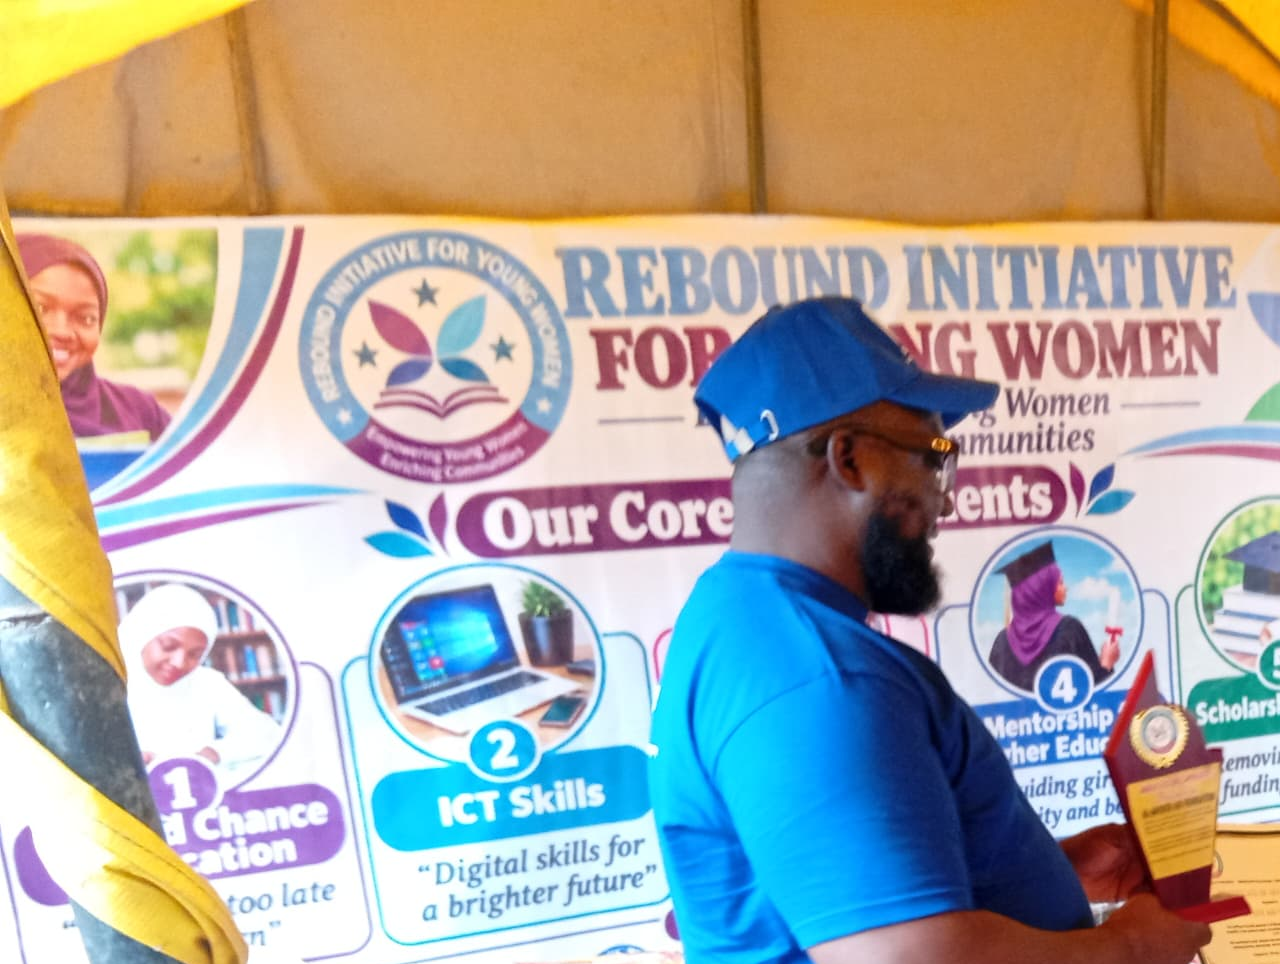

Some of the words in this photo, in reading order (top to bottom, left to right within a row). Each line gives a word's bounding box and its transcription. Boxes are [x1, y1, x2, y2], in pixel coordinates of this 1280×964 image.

[324, 238, 423, 308] INITIATIVE
[427, 236, 470, 265] FOR
[477, 246, 539, 308] YOUNG
[555, 244, 890, 319] REBOUND
[902, 244, 1238, 312] INITIATIVE
[986, 318, 1221, 382] WOMEN
[1004, 385, 1111, 419] Women
[952, 422, 1096, 457] mmunities
[483, 496, 599, 551] Our
[609, 490, 735, 543] Core
[1050, 667, 1078, 703] 4
[983, 704, 1114, 740] Mentorship
[486, 727, 519, 770] 2
[163, 765, 198, 810] 1
[437, 789, 500, 828] ICT
[508, 777, 606, 819] Skills
[193, 800, 329, 841] Chance
[1066, 798, 1100, 821] and
[535, 838, 601, 872] skills
[603, 834, 646, 867] for
[227, 893, 273, 916] too
[281, 881, 337, 908] late
[422, 903, 438, 922] a
[448, 883, 559, 920] brighter
